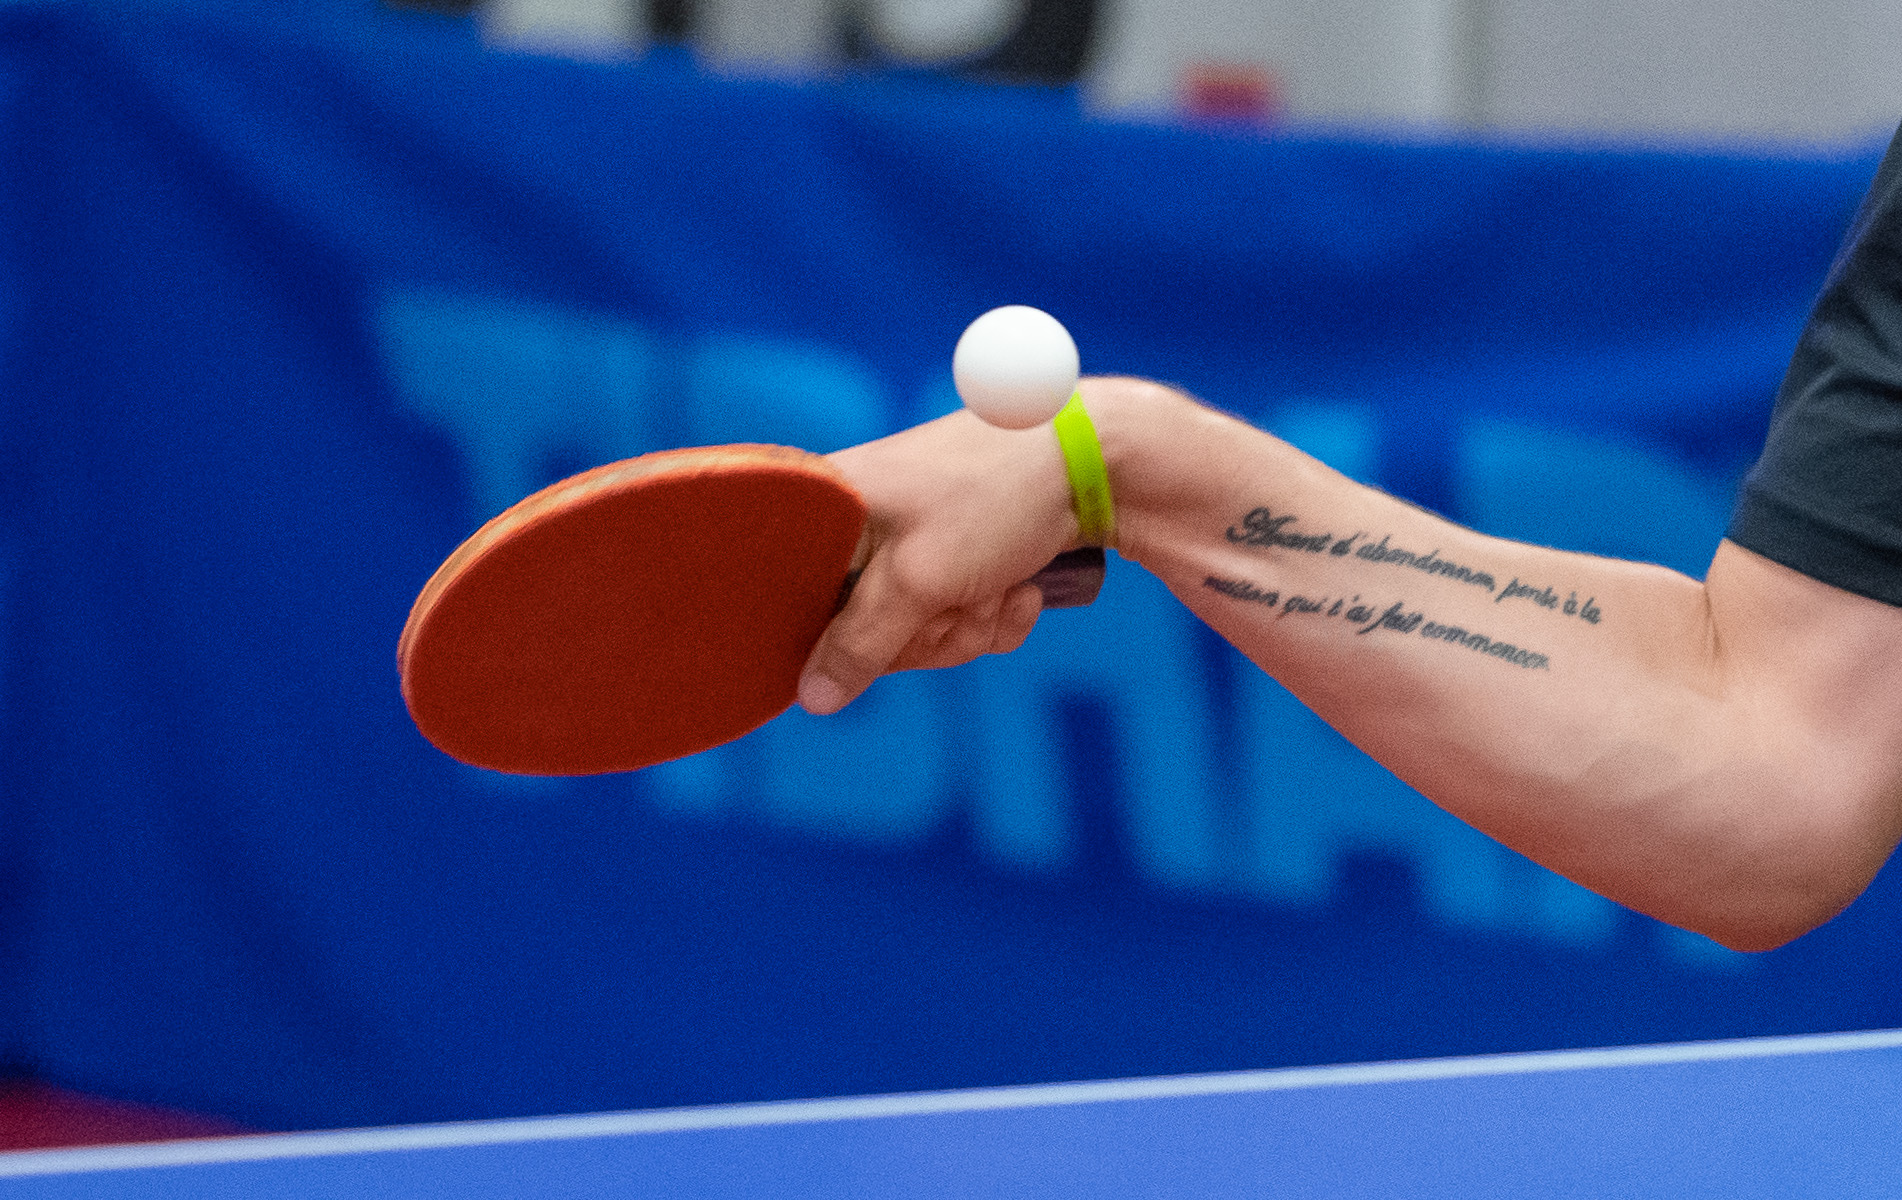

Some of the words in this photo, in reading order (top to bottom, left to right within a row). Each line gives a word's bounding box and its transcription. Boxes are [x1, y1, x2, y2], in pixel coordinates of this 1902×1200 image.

[1276, 595, 1328, 622] qui
[1356, 601, 1425, 635] fait
[1579, 597, 1602, 626] la
